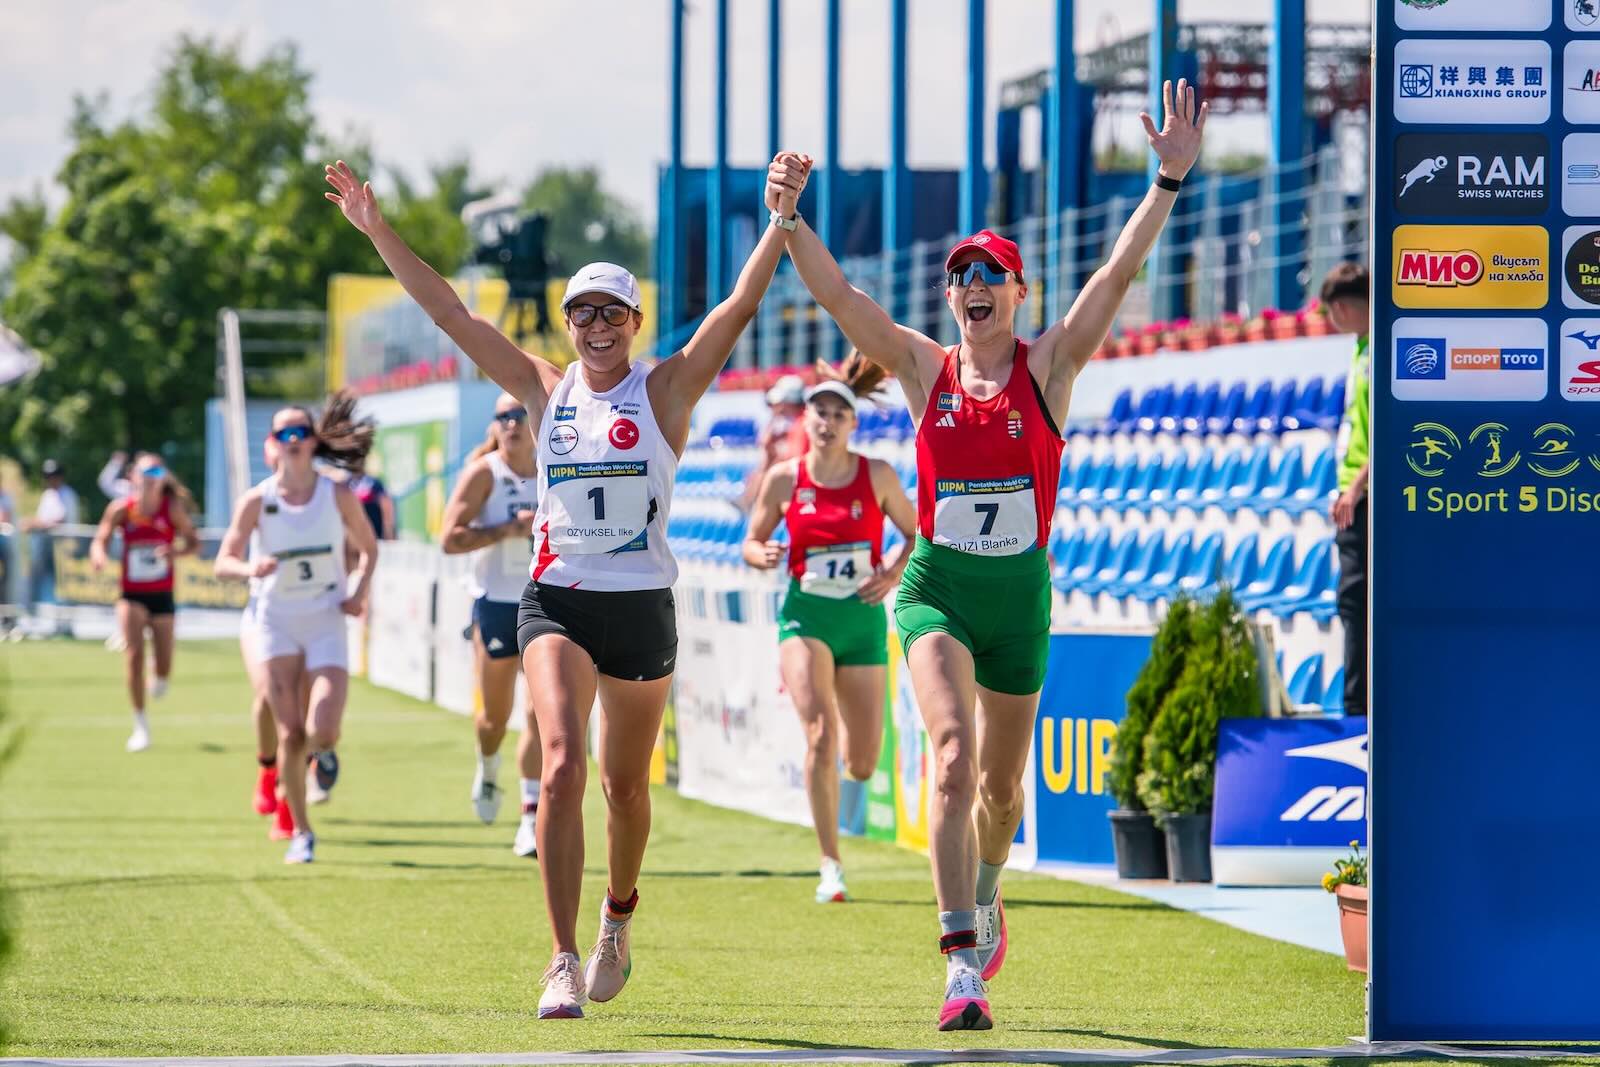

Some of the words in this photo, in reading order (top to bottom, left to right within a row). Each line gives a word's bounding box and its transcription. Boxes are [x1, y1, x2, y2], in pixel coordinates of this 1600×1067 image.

[1434, 89, 1502, 98] XIANGXING
[1506, 89, 1547, 98] GROUP
[1457, 155, 1545, 186] RAM
[1458, 189, 1492, 199] SWISS
[1495, 189, 1544, 199] WATCHES
[1400, 253, 1480, 282] МИО
[1492, 254, 1540, 269] вкусът
[1489, 273, 1504, 281] на
[1508, 269, 1544, 281] хляба
[1453, 354, 1499, 365] СПОРТ
[1503, 354, 1538, 365] ТОТО
[550, 467, 577, 478] UIPM
[579, 464, 612, 472] Pentathlon
[613, 463, 631, 471] World
[632, 463, 644, 471] Cup
[938, 482, 966, 493] UIPM
[968, 481, 1003, 489] Pentathlon
[1018, 478, 1030, 486] Cup
[587, 487, 605, 521] 1
[1403, 486, 1417, 512] 1
[1427, 487, 1509, 518] Sport
[1519, 486, 1538, 512] 5
[974, 503, 999, 536] 7
[567, 528, 616, 537] OZYUKSEL
[618, 528, 634, 537] Ilke
[981, 537, 1018, 550] Blanka
[298, 561, 313, 581] 3
[826, 559, 857, 580] 14
